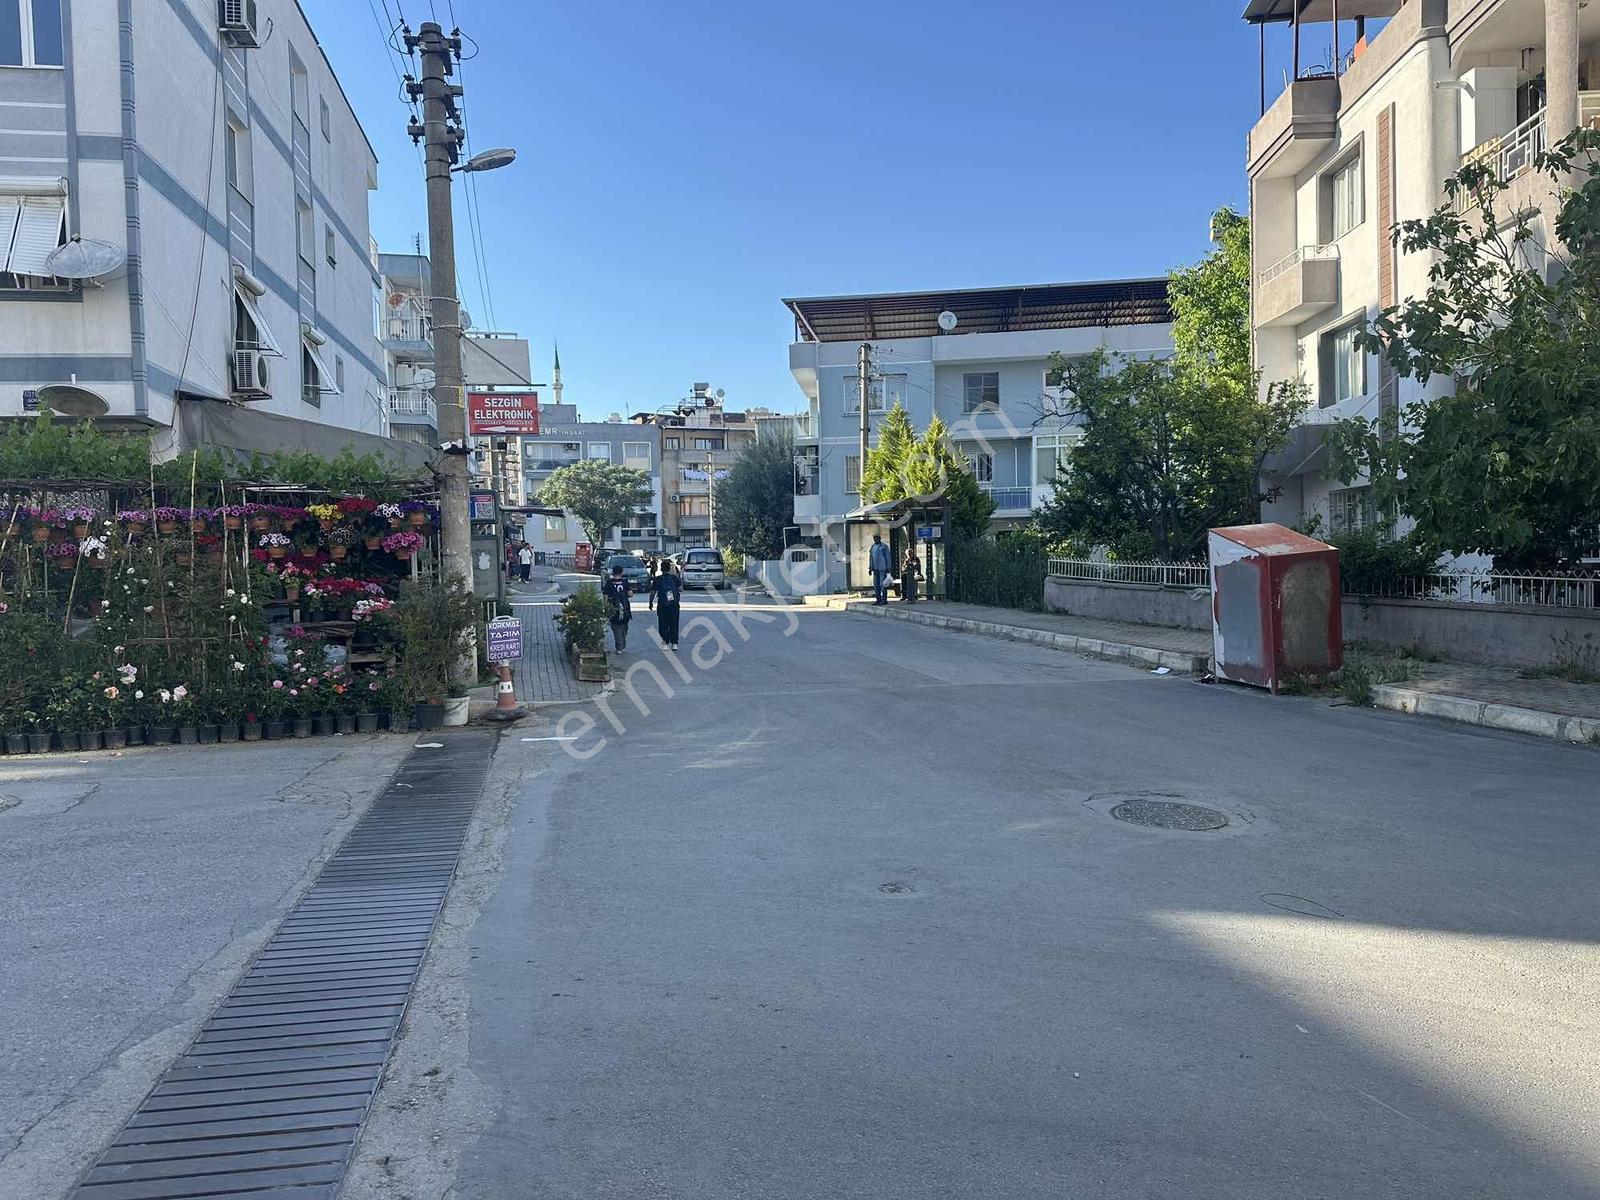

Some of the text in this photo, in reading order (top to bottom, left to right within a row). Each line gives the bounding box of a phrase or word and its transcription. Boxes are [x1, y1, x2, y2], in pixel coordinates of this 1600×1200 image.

[484, 396, 521, 407] SEZGİN
[474, 407, 534, 419] ELEKTRONİK
[489, 620, 521, 630] KORKMAZ
[490, 630, 521, 639] TARIM
